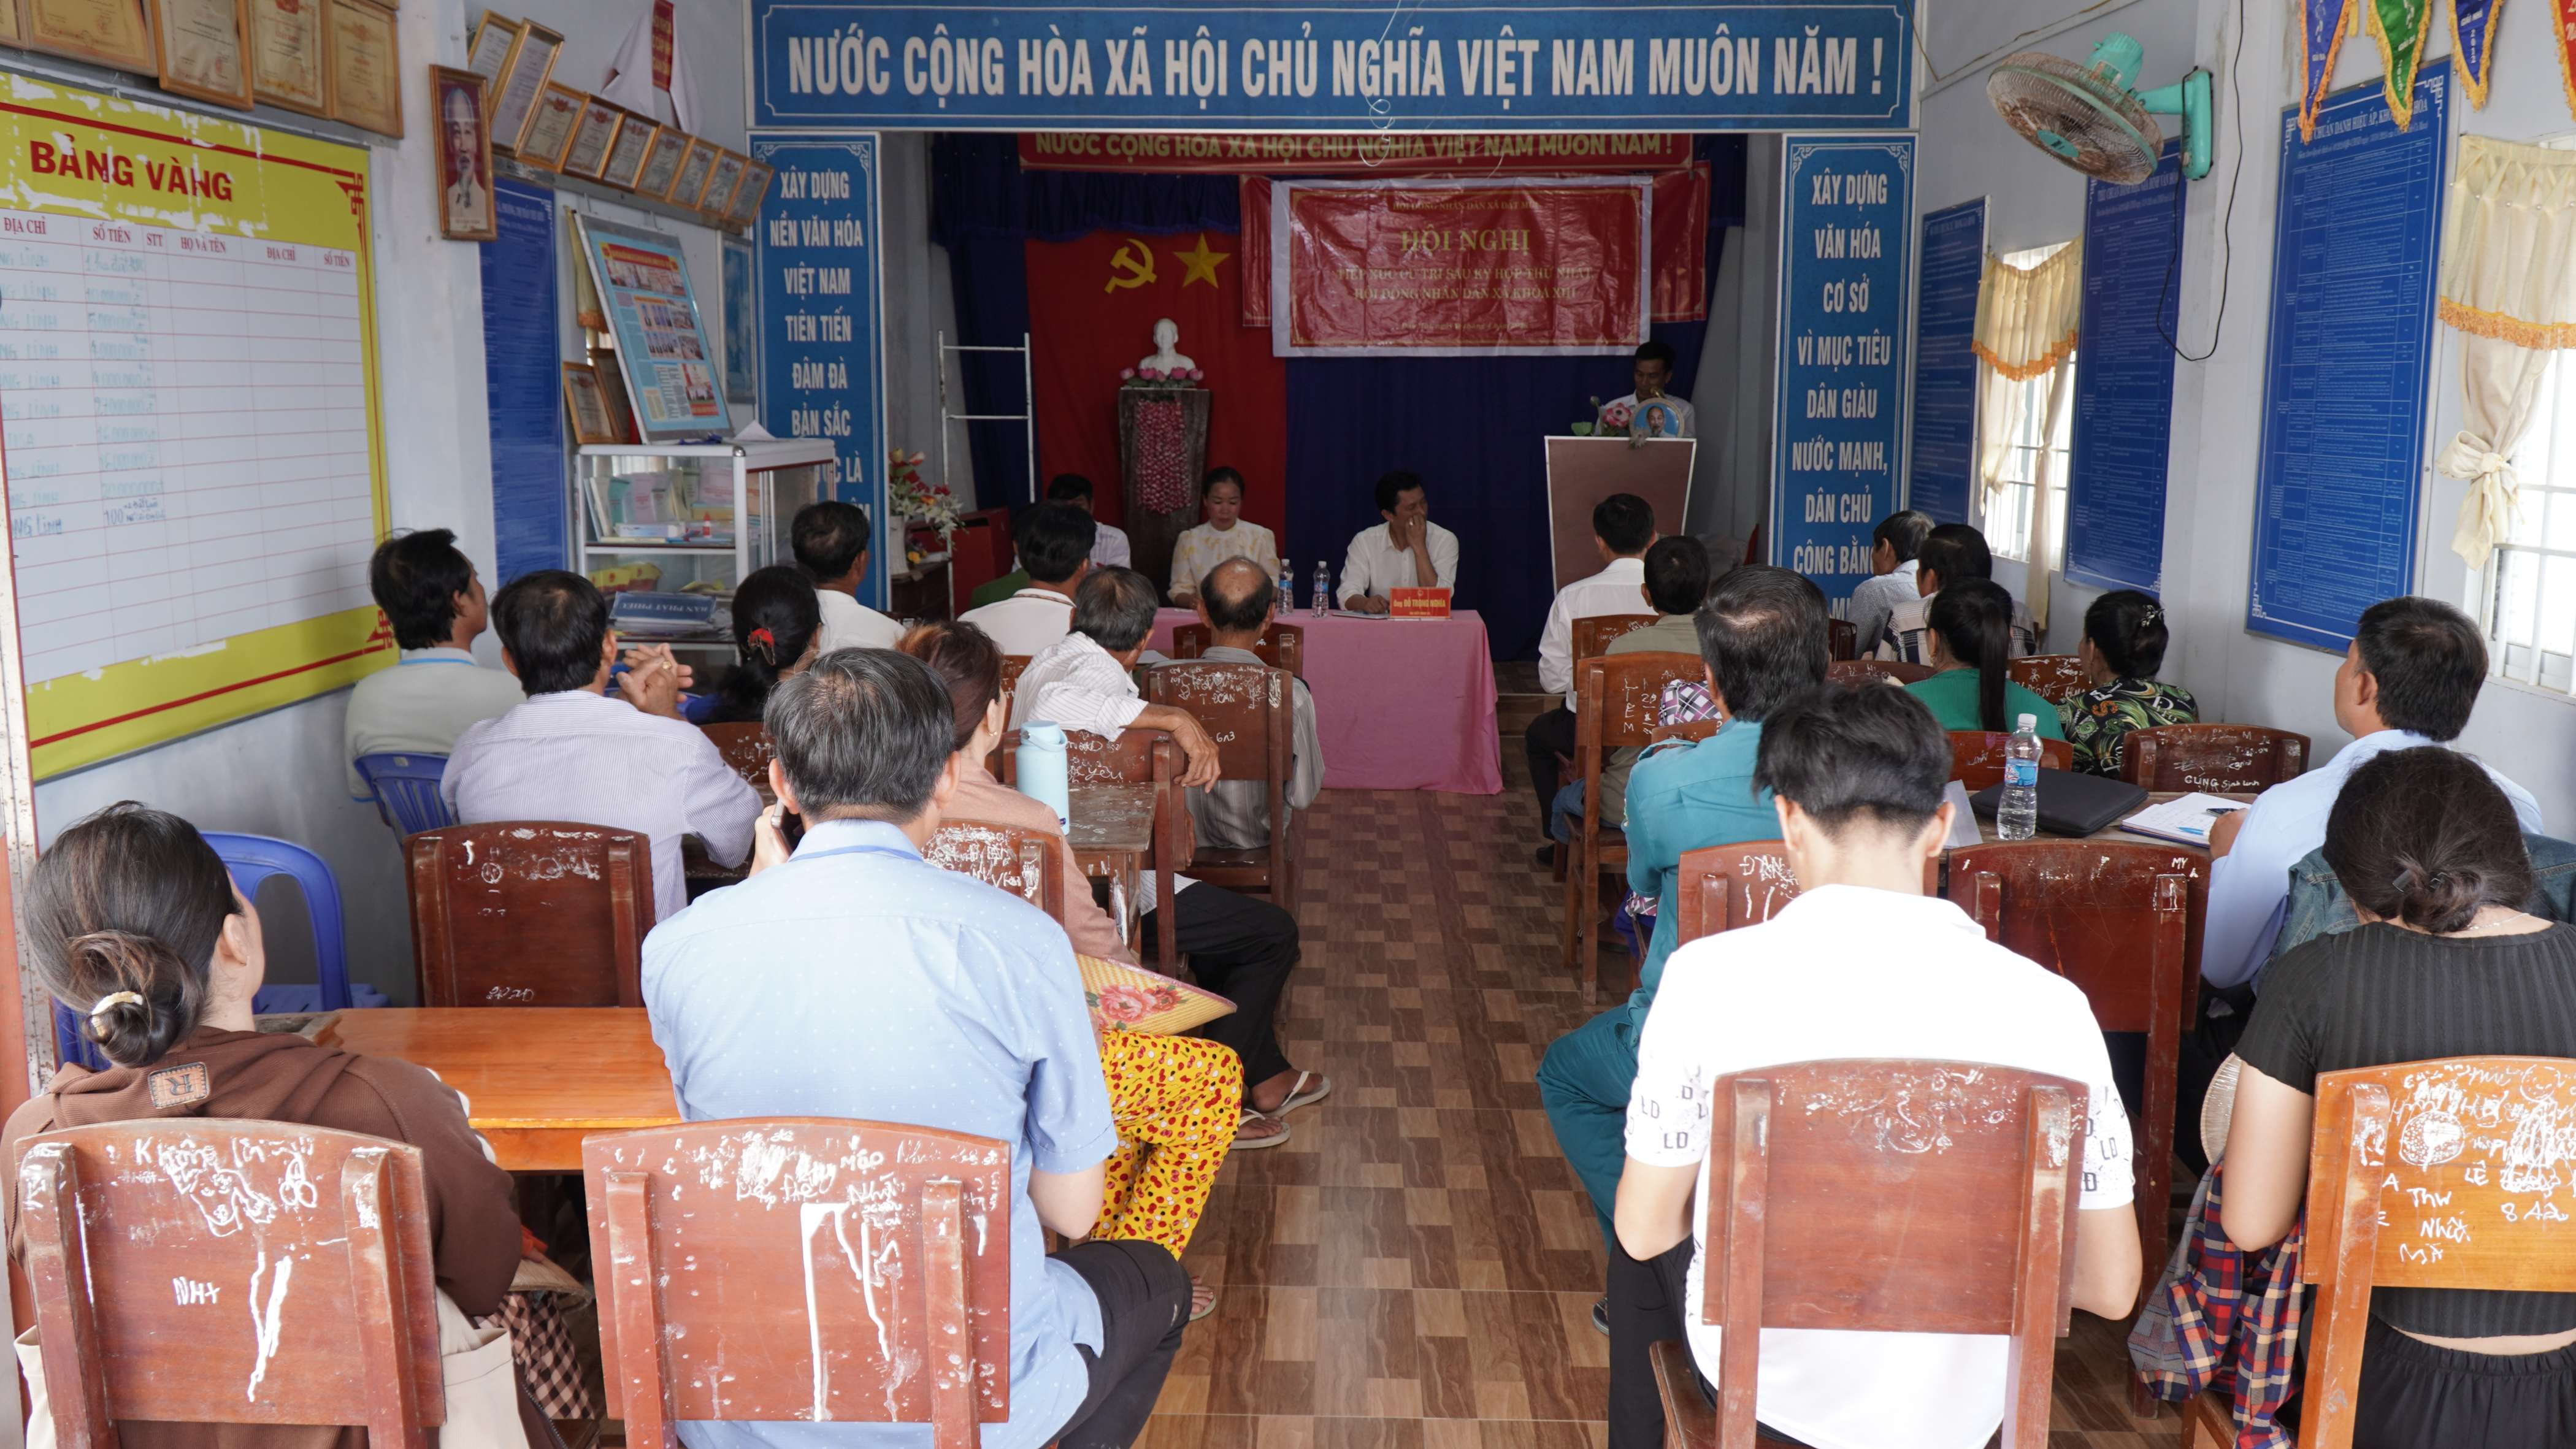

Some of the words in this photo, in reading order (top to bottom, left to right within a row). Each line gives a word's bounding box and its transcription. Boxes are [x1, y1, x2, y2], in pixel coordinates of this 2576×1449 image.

[788, 23, 889, 95] NƯỚC
[904, 23, 1004, 109] CỘNG
[1018, 24, 1094, 96] HÒA
[1105, 25, 1152, 96] XÃ
[1165, 25, 1227, 110] HỘI
[1241, 21, 1318, 97] CHỦ
[1333, 26, 1446, 97] NGHĨA
[1458, 25, 1539, 110] VIỆT
[1552, 39, 1634, 96] NAM
[1649, 23, 1760, 96] MUÔN
[1774, 25, 1857, 94] NĂM
[1871, 37, 1883, 94] !
[1484, 134, 1533, 157] NAM
[30, 133, 134, 188] BẢNG
[146, 156, 232, 202] VÀNG
[780, 165, 807, 198] XÂY
[811, 168, 849, 205] DỰNG
[1811, 167, 1842, 205] XÂY
[1846, 170, 1888, 212] DỰNG
[4, 218, 24, 235] ĐỊA
[27, 216, 46, 235] CHỈ
[93, 223, 105, 240] SỐ
[147, 233, 163, 247] STT
[770, 210, 797, 247] NỀN
[802, 215, 829, 247] VĂN
[834, 213, 863, 247] HÓA
[1401, 224, 1451, 252] HỘI
[1460, 229, 1530, 256] NGHỊ
[1815, 223, 1846, 259] VĂN
[1850, 221, 1881, 259] HÓA
[784, 261, 815, 300] VIỆT
[819, 268, 851, 294] NAM
[1823, 278, 1845, 313] CƠ
[1849, 273, 1870, 313] SỞ
[785, 309, 816, 342] TIÊN
[820, 306, 852, 342] TIẾN
[1797, 329, 1812, 365] VÌ
[1817, 335, 1852, 372] MỤC
[1857, 328, 1891, 365] TIÊU
[792, 356, 824, 396] ĐẬM
[828, 356, 848, 389] ĐÀ
[792, 402, 819, 436] BẢN
[824, 400, 851, 437] SẮC
[1806, 382, 1837, 419] DÂN
[1842, 382, 1877, 419] GIÀU
[846, 450, 863, 483] LÀ
[1792, 434, 1834, 471] NƯỚC
[1839, 442, 1888, 478] MẠNH,
[1805, 487, 1835, 522] DÂN
[1840, 485, 1871, 523] CHỦ
[1793, 539, 1834, 575] CÔNG
